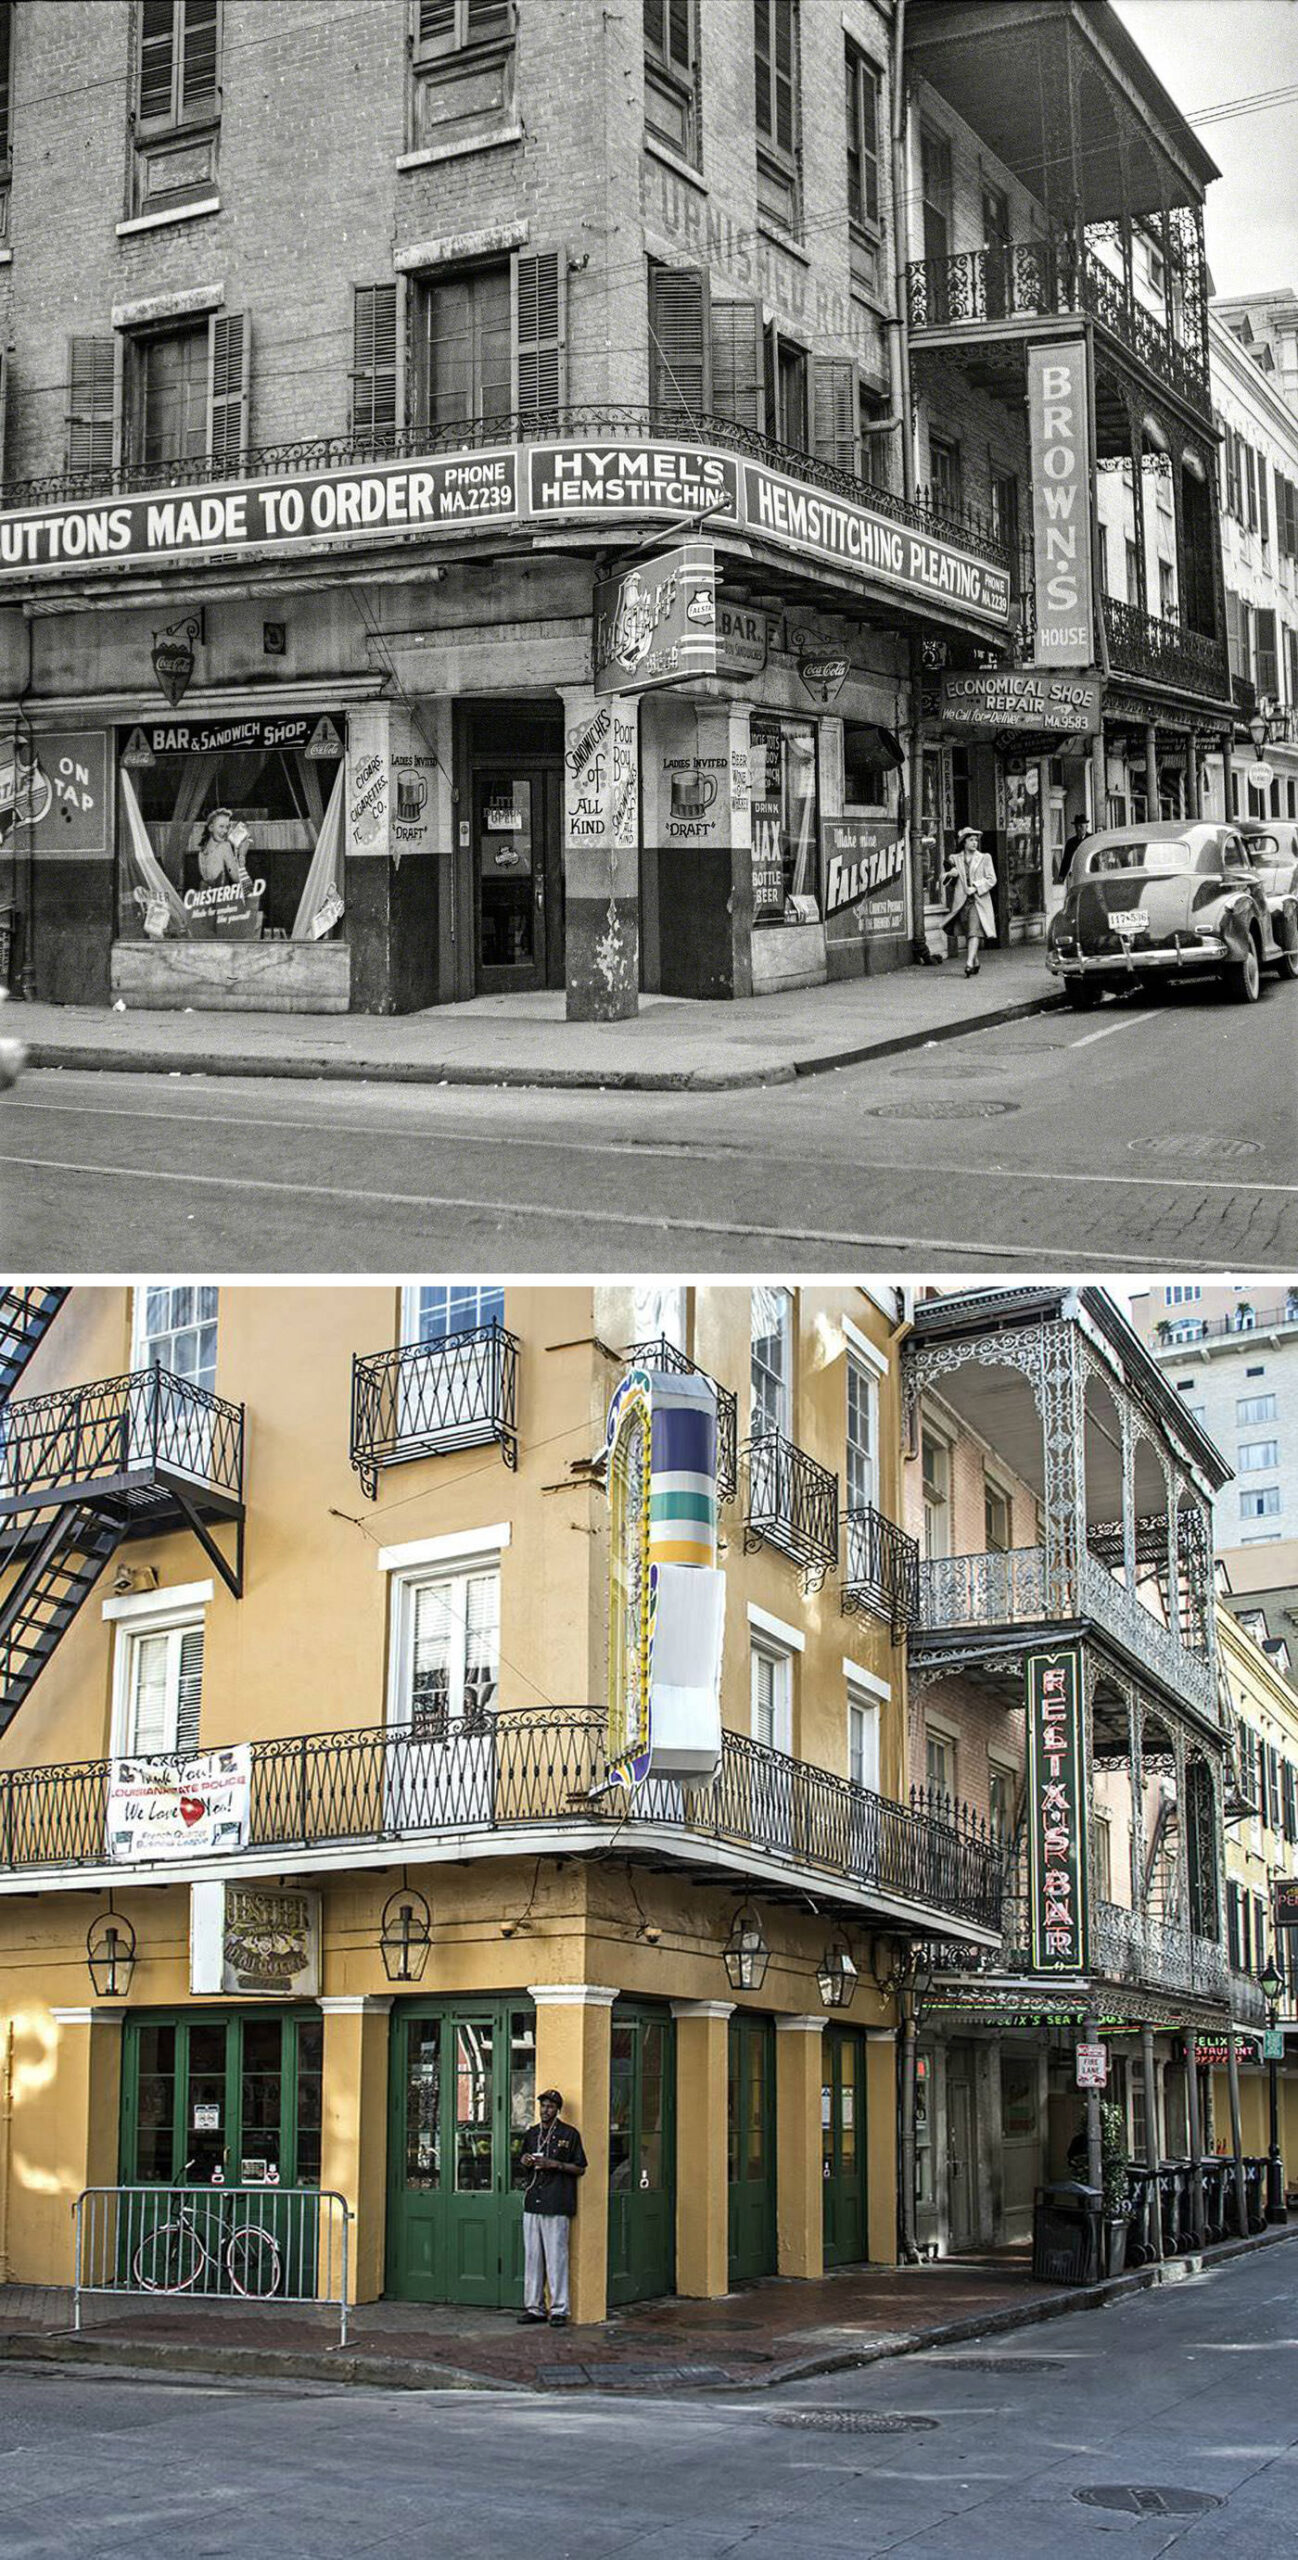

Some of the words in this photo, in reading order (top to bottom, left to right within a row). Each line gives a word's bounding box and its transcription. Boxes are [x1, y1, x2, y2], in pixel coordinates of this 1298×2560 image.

[444, 462, 506, 486] PHONE
[554, 452, 724, 485] HYMEL'S
[146, 495, 249, 547] MADE
[258, 488, 305, 535] TO
[311, 471, 435, 526] ORDER
[439, 485, 512, 514] MA.2239
[757, 478, 903, 572] HEMSTITCHING
[909, 542, 981, 606] PLEATING
[984, 573, 1005, 593] PHONE
[1040, 626, 1088, 647] HOUSE
[945, 678, 1045, 699] ECONOMICAL
[1049, 684, 1094, 709] SHOE
[986, 695, 1045, 713] REPAIR
[153, 728, 190, 750] BAR
[190, 738, 201, 751] &
[201, 722, 260, 750] SANDWICH
[565, 708, 611, 780] SANDWICHES
[58, 757, 91, 786] ON
[587, 753, 606, 794] of
[663, 758, 691, 769] LADIES
[693, 757, 728, 769] INVITED
[54, 778, 95, 812] TAP
[568, 797, 603, 816] ALL
[754, 803, 780, 814] DRINK
[570, 818, 606, 835] KIND
[751, 820, 782, 862] JAX
[751, 871, 782, 887] BOTTLE
[827, 837, 905, 911] FALSTAFF
[184, 879, 266, 910] CHESTERFID
[755, 888, 779, 904] BEER
[201, 1775, 246, 1790] POLICE
[125, 1800, 144, 1821] We
[1047, 2014, 1071, 2025] SEA
